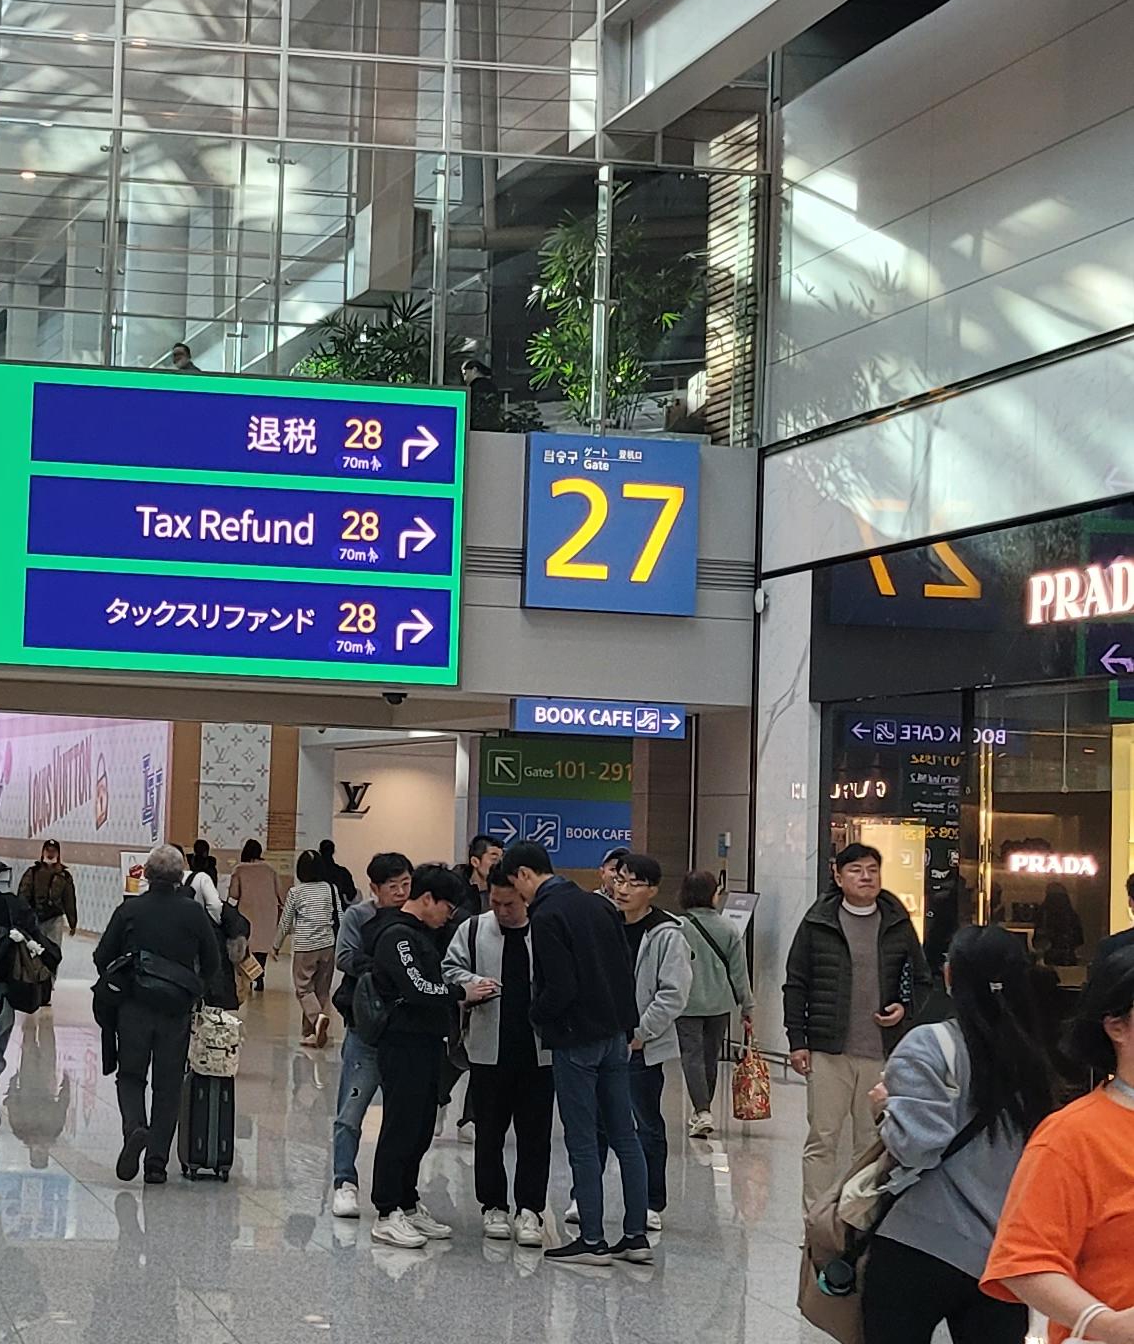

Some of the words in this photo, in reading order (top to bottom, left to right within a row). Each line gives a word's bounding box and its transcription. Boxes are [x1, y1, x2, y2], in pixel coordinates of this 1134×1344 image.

[247, 415, 317, 455] 退税
[344, 418, 383, 451] 28
[342, 456, 370, 471] 70m
[583, 459, 610, 471] Gate
[136, 506, 192, 540] Tax
[200, 508, 315, 546] Refund
[341, 510, 380, 542] 28
[545, 477, 685, 583] 27
[339, 548, 367, 563] 70m
[105, 598, 315, 634] タックスリファンド
[338, 602, 377, 635] 28
[336, 640, 364, 655] 70m
[534, 706, 586, 725] BOOK
[588, 709, 633, 727] CAFE
[28, 765, 52, 839] LOUIS
[53, 734, 92, 824] VUITTON
[524, 766, 554, 778] Gates
[339, 781, 372, 813] LV
[565, 827, 599, 839] BOOK
[602, 829, 632, 841] CAFE
[1009, 853, 1098, 876] PRADA
